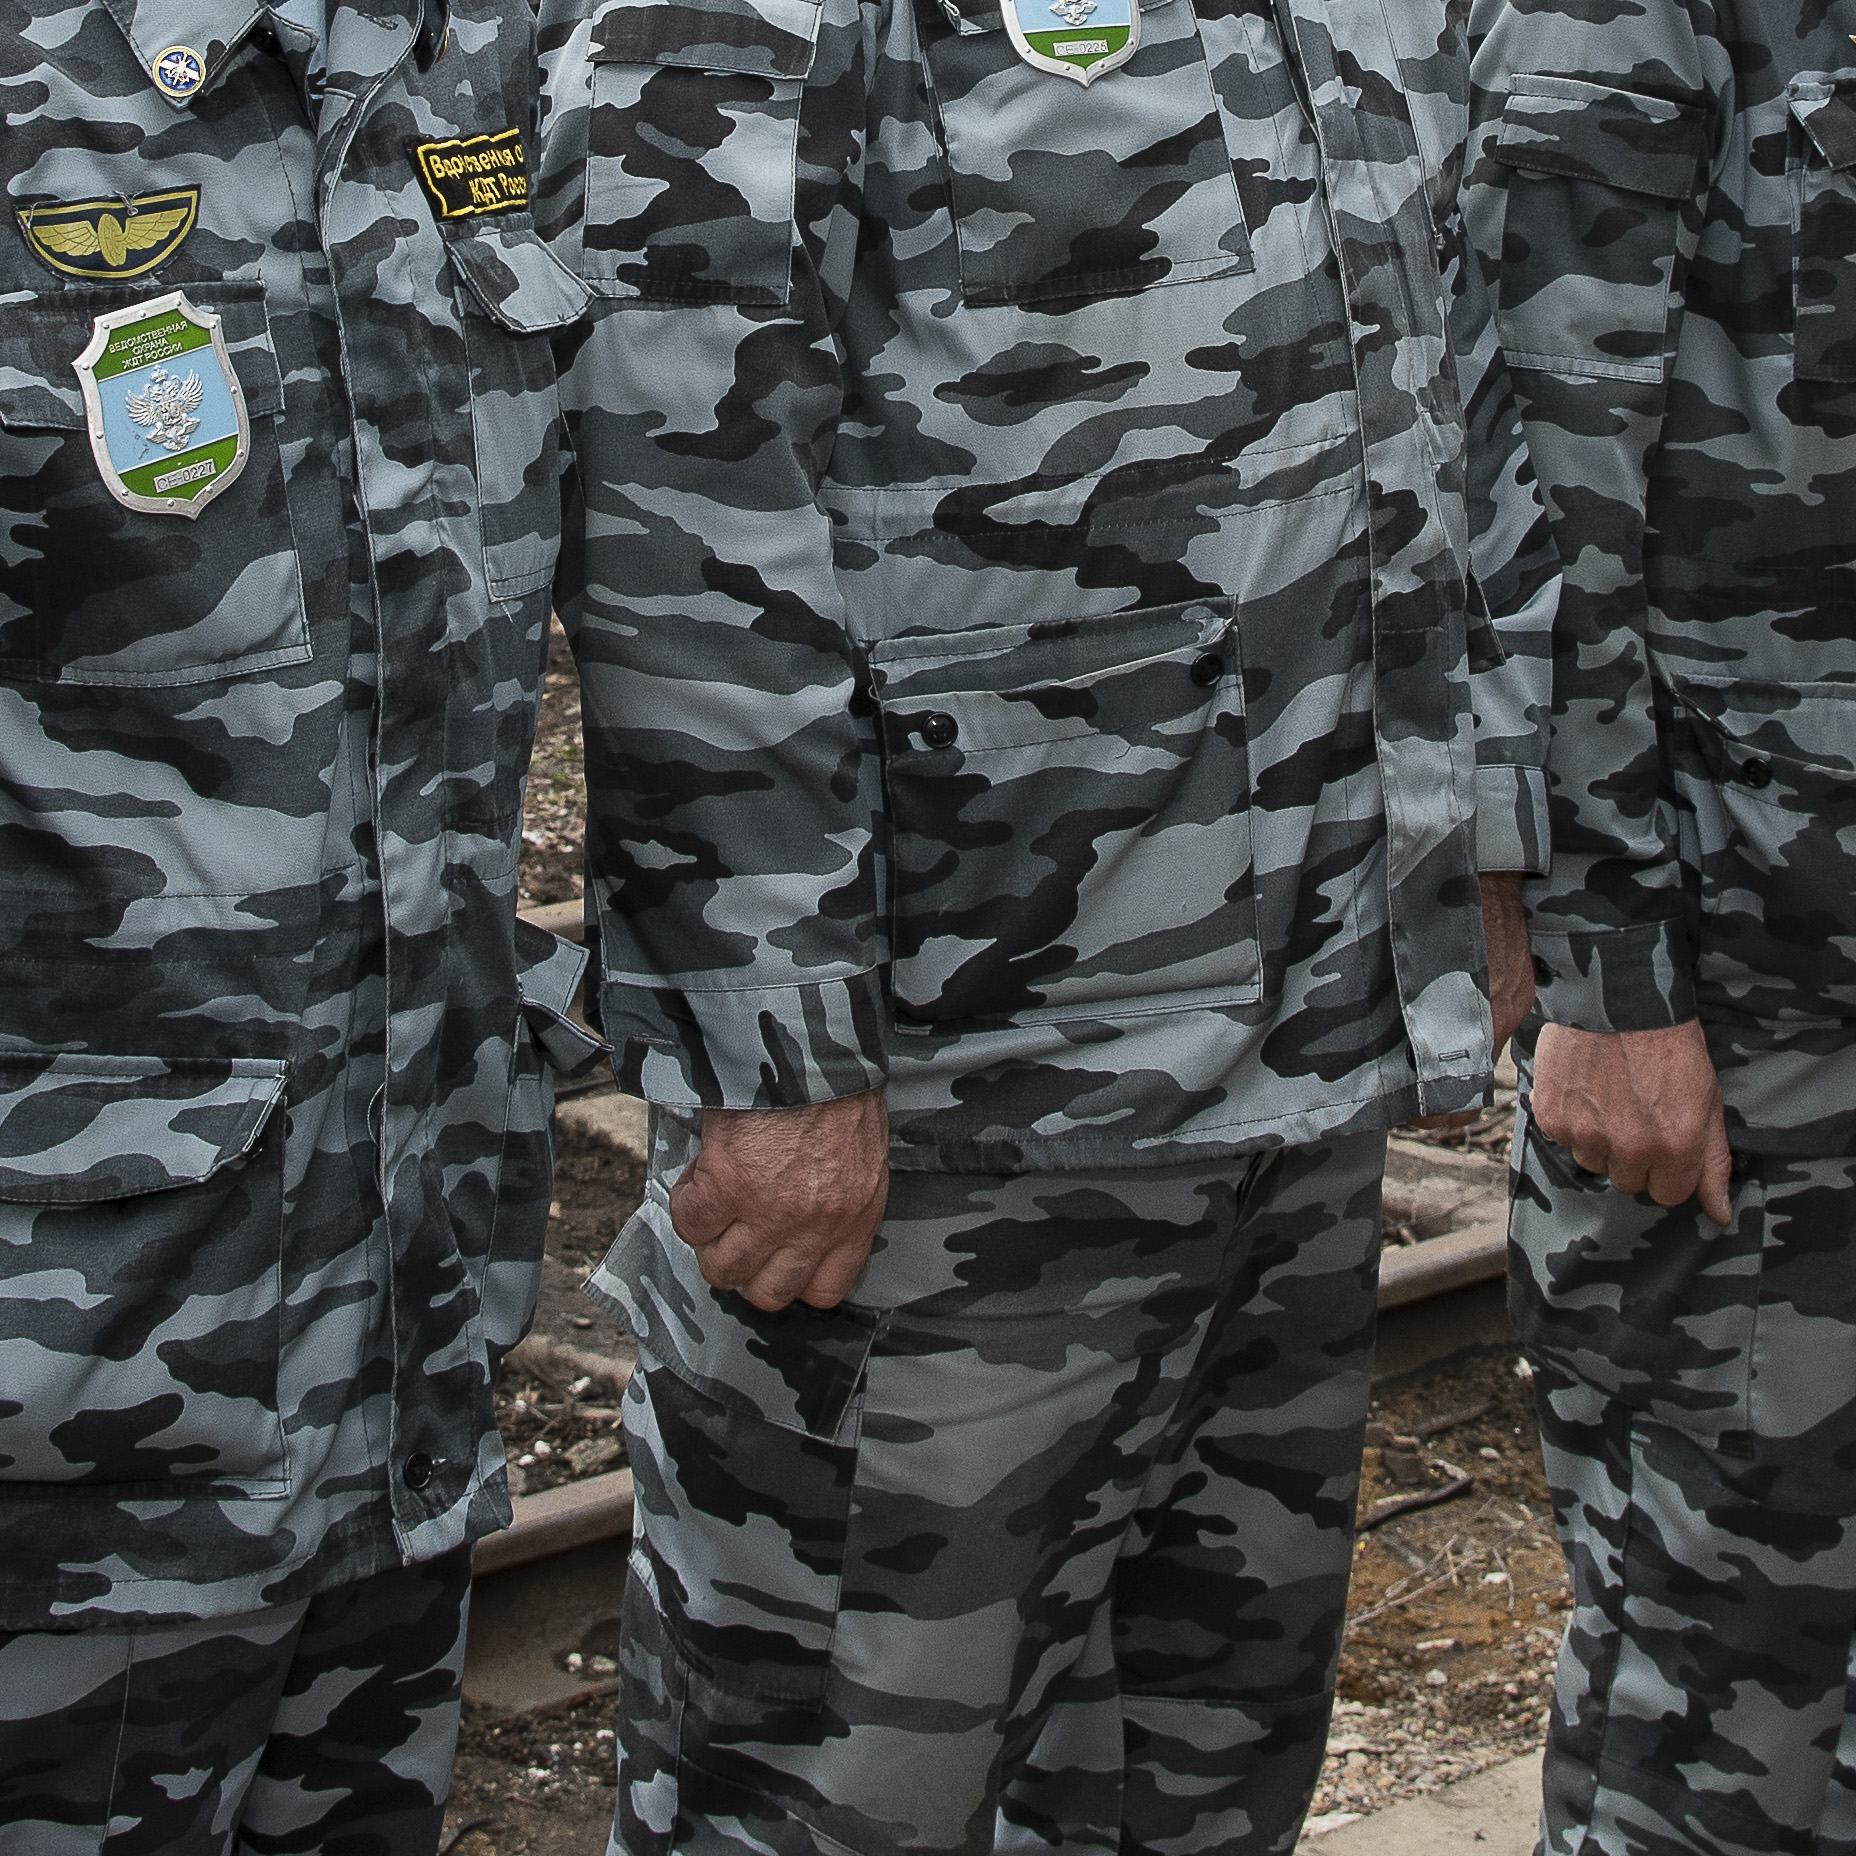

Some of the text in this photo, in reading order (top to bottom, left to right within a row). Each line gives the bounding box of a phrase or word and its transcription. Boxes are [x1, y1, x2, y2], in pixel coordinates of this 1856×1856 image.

[108, 320, 189, 355] ВЕДОМСТВЕННАЯ
[131, 337, 170, 356] ОХРАНА
[122, 341, 183, 370] ЖДТ РОССИИ
